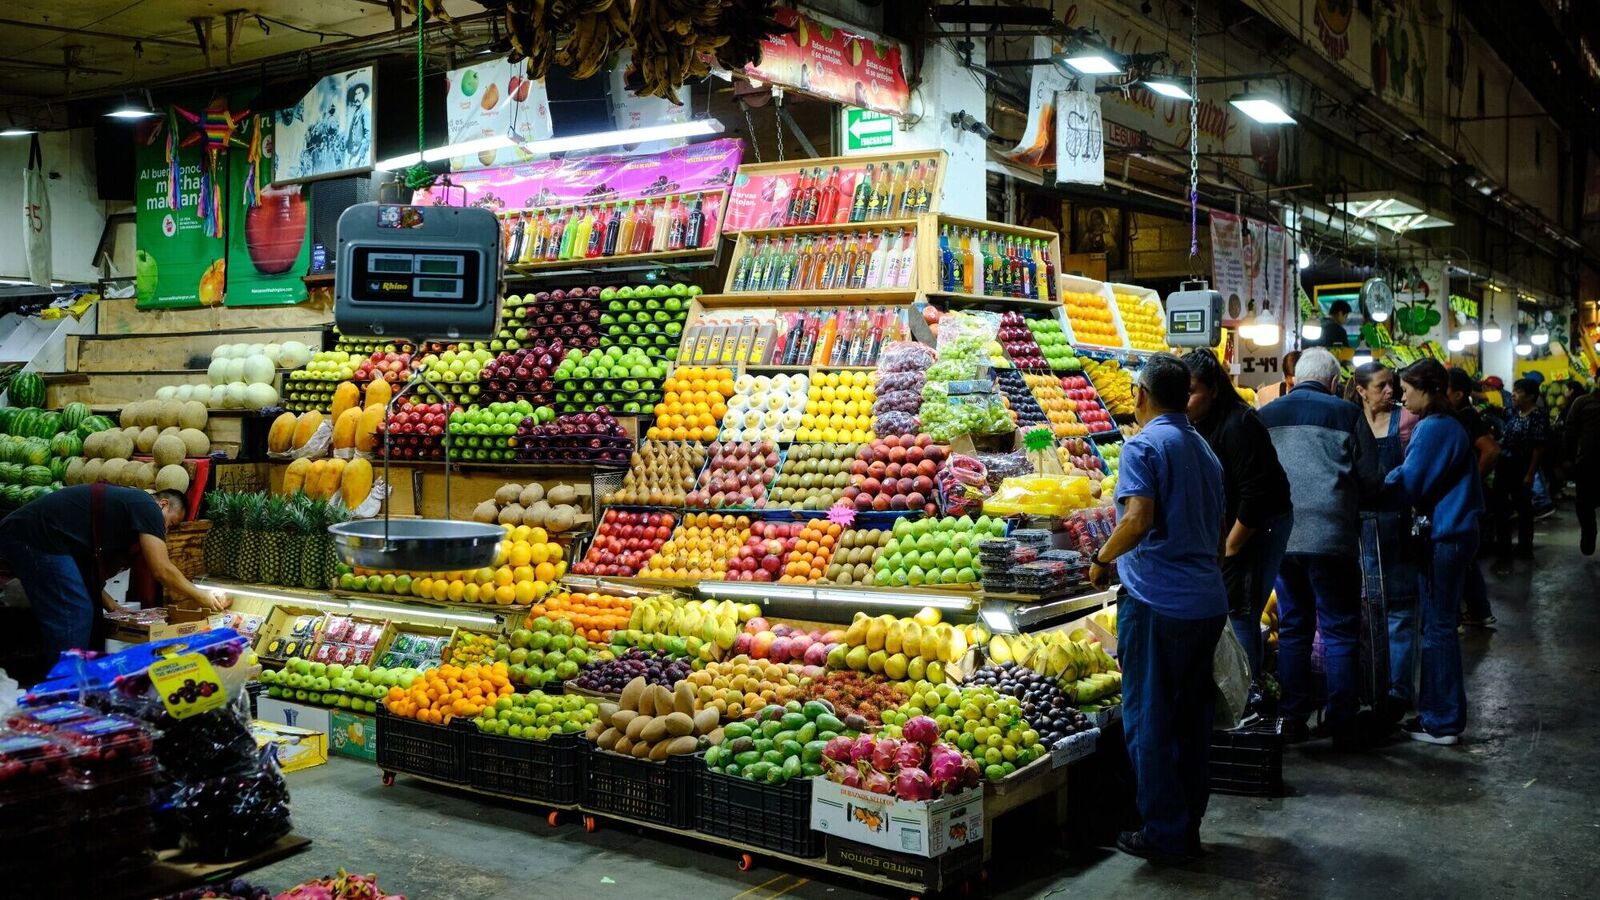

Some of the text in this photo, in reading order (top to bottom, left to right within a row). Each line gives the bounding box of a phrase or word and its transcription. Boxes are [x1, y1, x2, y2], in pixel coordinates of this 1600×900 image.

[382, 281, 408, 291] Rhino
[1242, 356, 1278, 373] I-49
[840, 850, 924, 878] LIMITED EDITION
